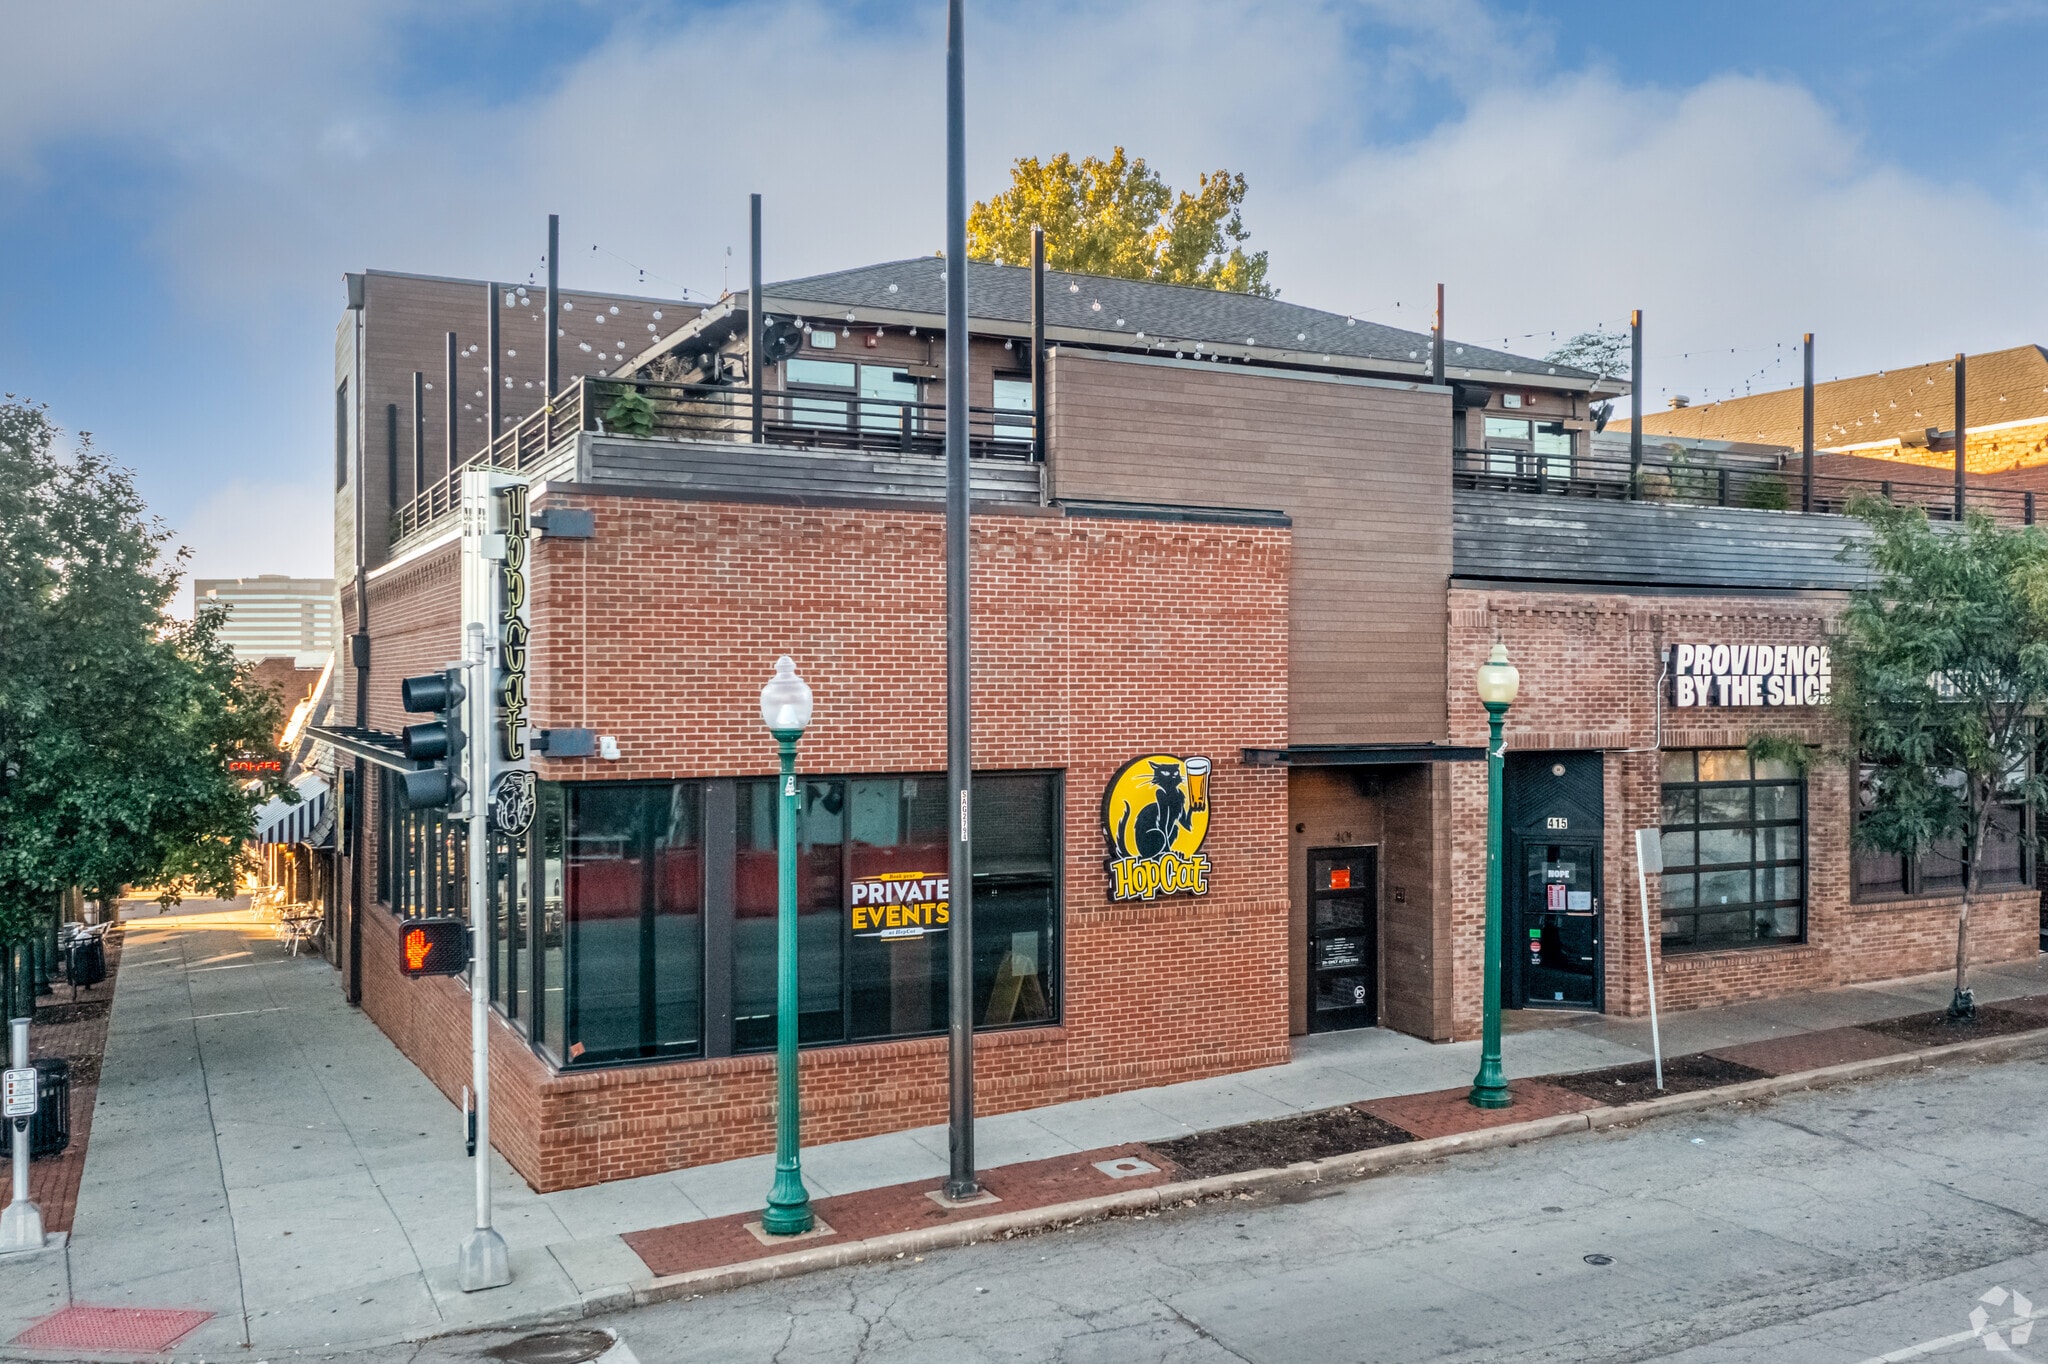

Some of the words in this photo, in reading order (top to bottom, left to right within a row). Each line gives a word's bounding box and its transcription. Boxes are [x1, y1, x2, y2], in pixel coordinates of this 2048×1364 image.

[503, 484, 529, 761] HopCat
[1676, 644, 1832, 676] PROVIDENCE
[1677, 675, 1713, 707] BY
[1717, 675, 1763, 706] THE
[1767, 675, 1832, 706] SLICE
[1548, 818, 1567, 829] 415
[852, 879, 949, 905] PRIVATE
[1111, 852, 1211, 900] HopCat
[852, 902, 949, 929] EVENTS
